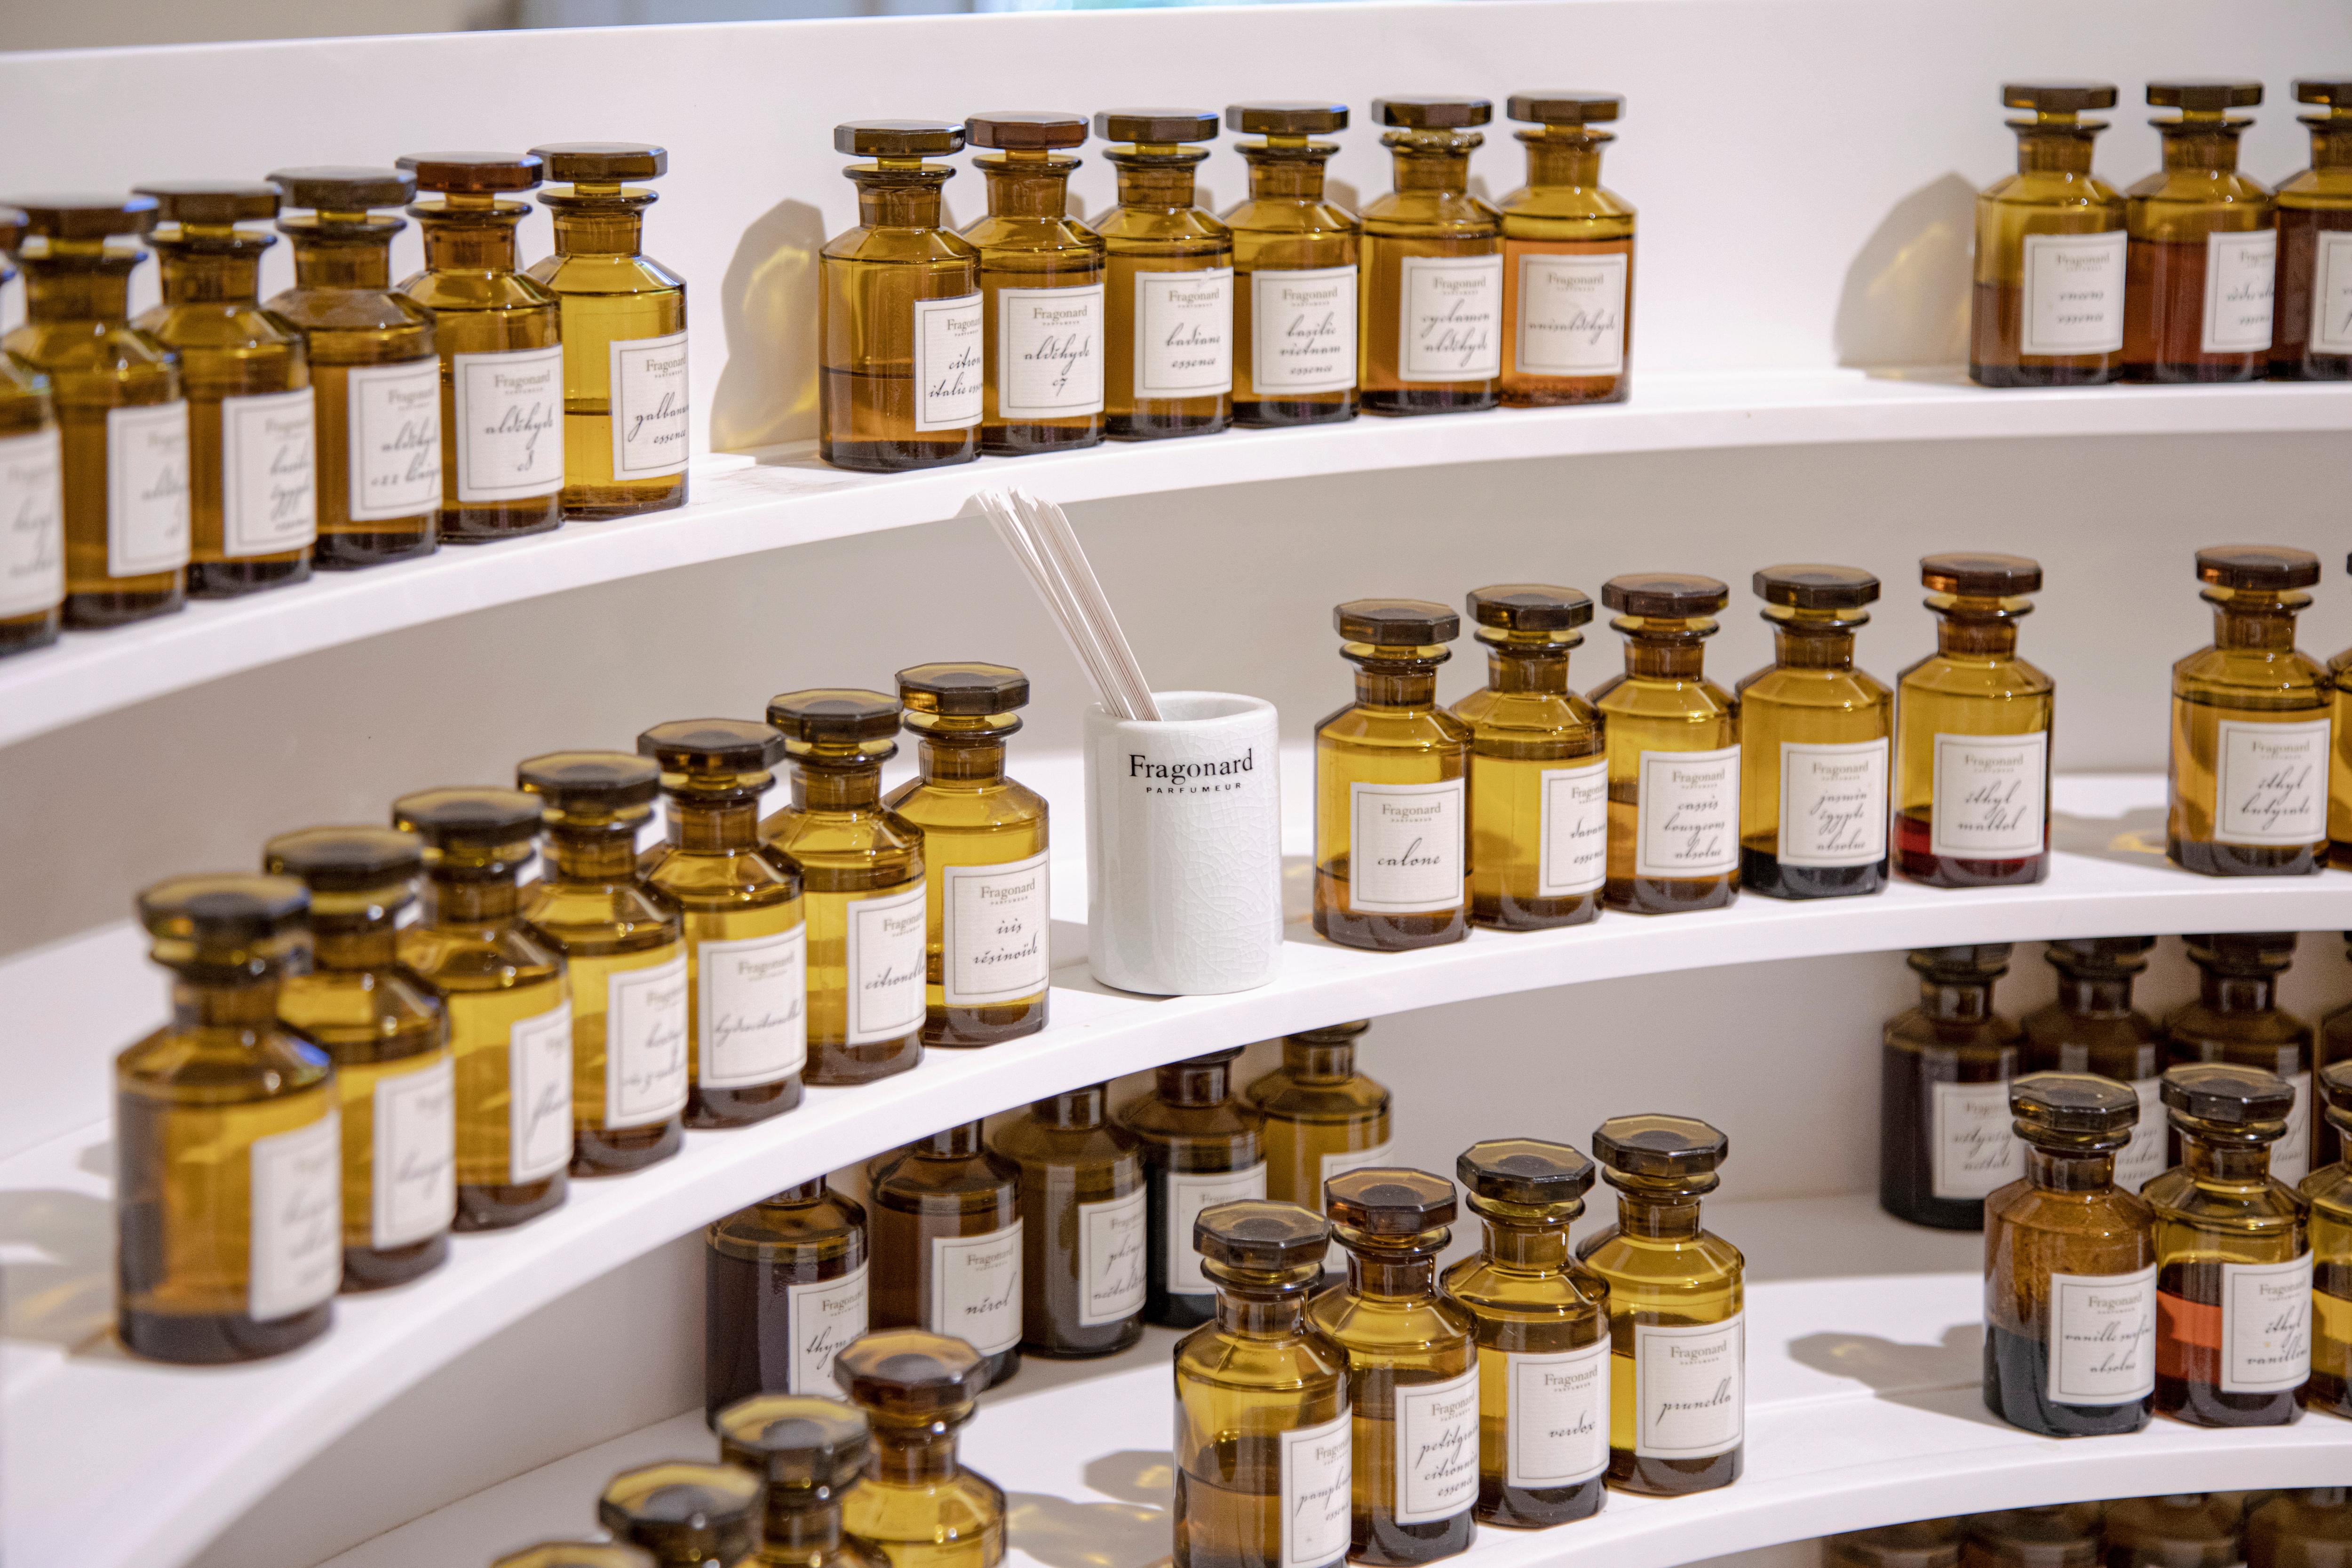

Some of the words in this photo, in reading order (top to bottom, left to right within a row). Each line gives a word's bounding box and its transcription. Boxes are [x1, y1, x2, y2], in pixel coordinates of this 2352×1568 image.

[1169, 288, 1220, 303] Fragonard
[1282, 287, 1337, 302] Fragonard
[1033, 306, 1087, 321] Fragonard
[646, 353, 686, 373] Fragonard
[949, 346, 981, 370] citron
[653, 428, 686, 445] essence
[1129, 747, 1253, 785] Fragonard
[1673, 768, 1725, 784] Fragonard
[1146, 782, 1241, 794] PARFUMEUR
[1382, 802, 1441, 818] Fragonard
[1678, 795, 1718, 811] cassis
[1378, 837, 1440, 866] calone
[981, 878, 1035, 899] Fragonard
[996, 918, 1022, 934] iris
[966, 1271, 1017, 1315] nérol
[1670, 1340, 1726, 1361] Fragonard
[1544, 1365, 1598, 1387] Fragonard
[1431, 1389, 1476, 1416] Fragonard
